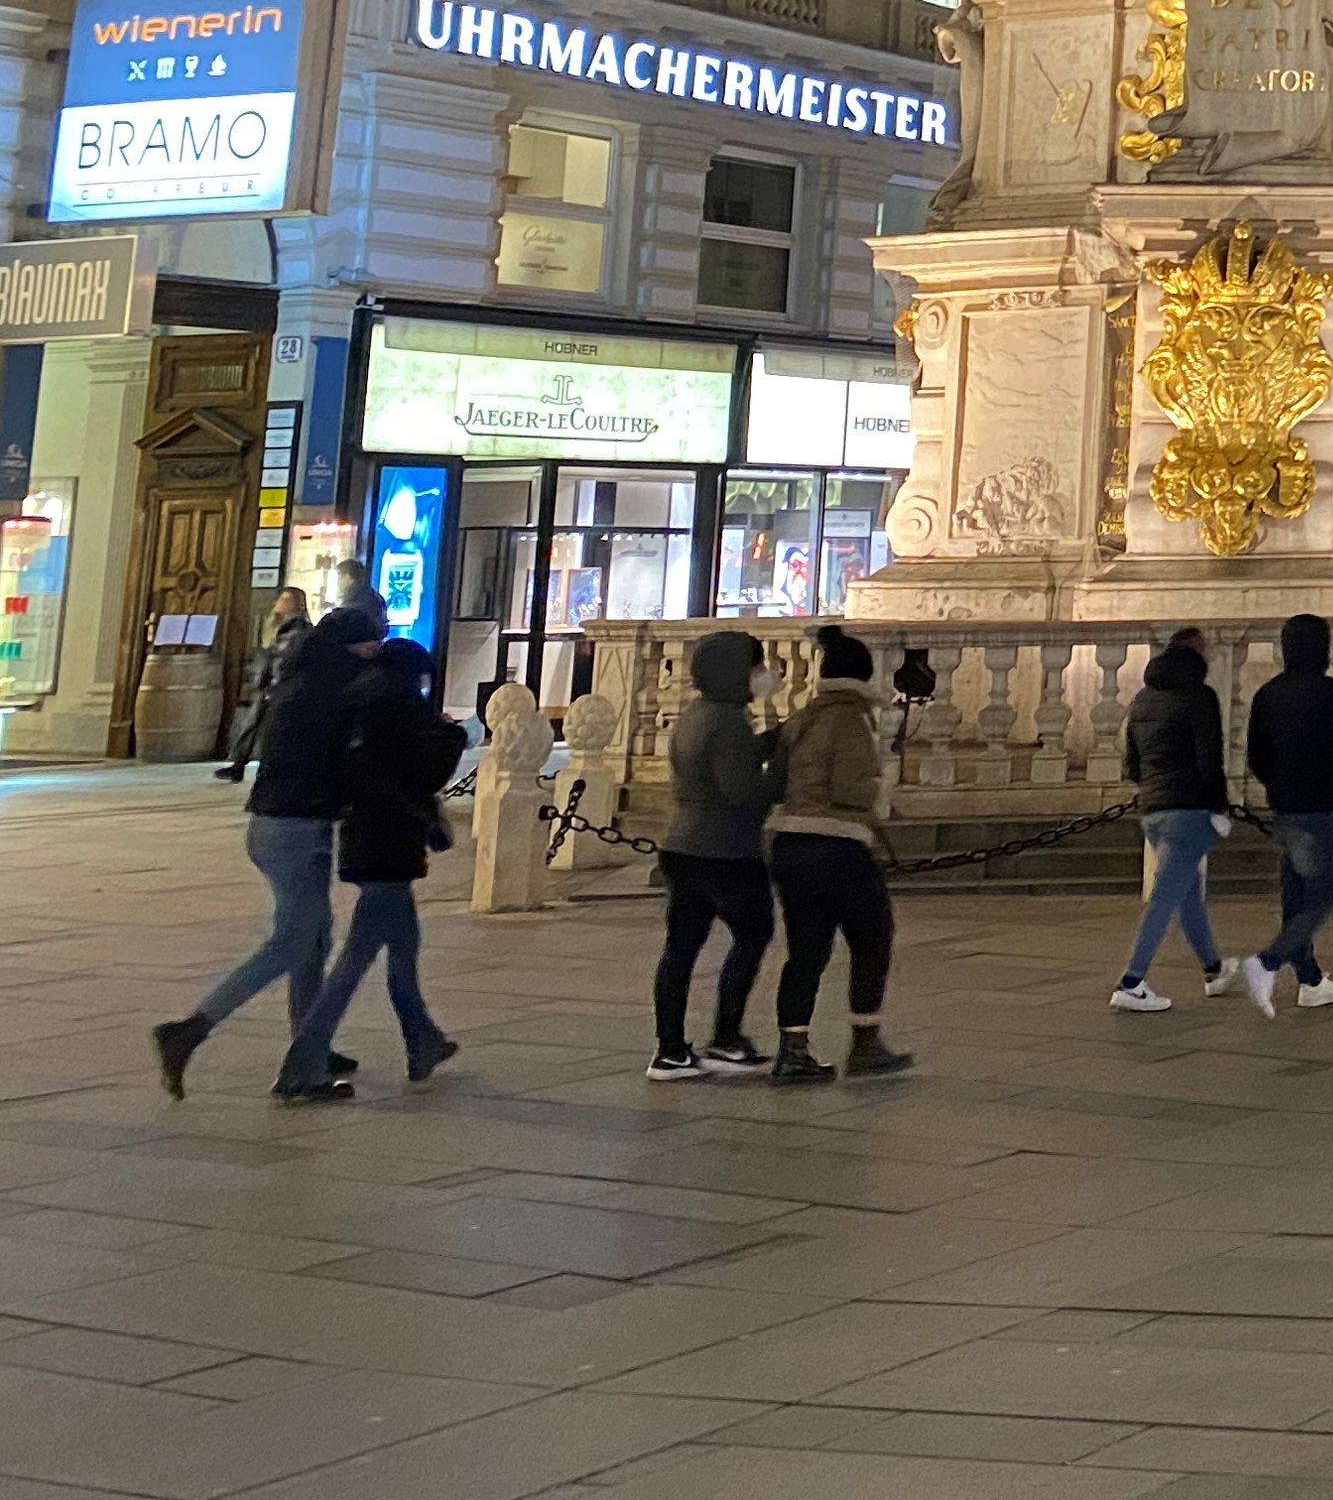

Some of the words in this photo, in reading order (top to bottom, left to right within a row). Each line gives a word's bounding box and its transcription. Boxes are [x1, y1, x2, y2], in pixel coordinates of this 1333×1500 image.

[94, 5, 281, 45] wienerin
[78, 111, 266, 169] BRAMO
[81, 180, 253, 200] COFFEUR
